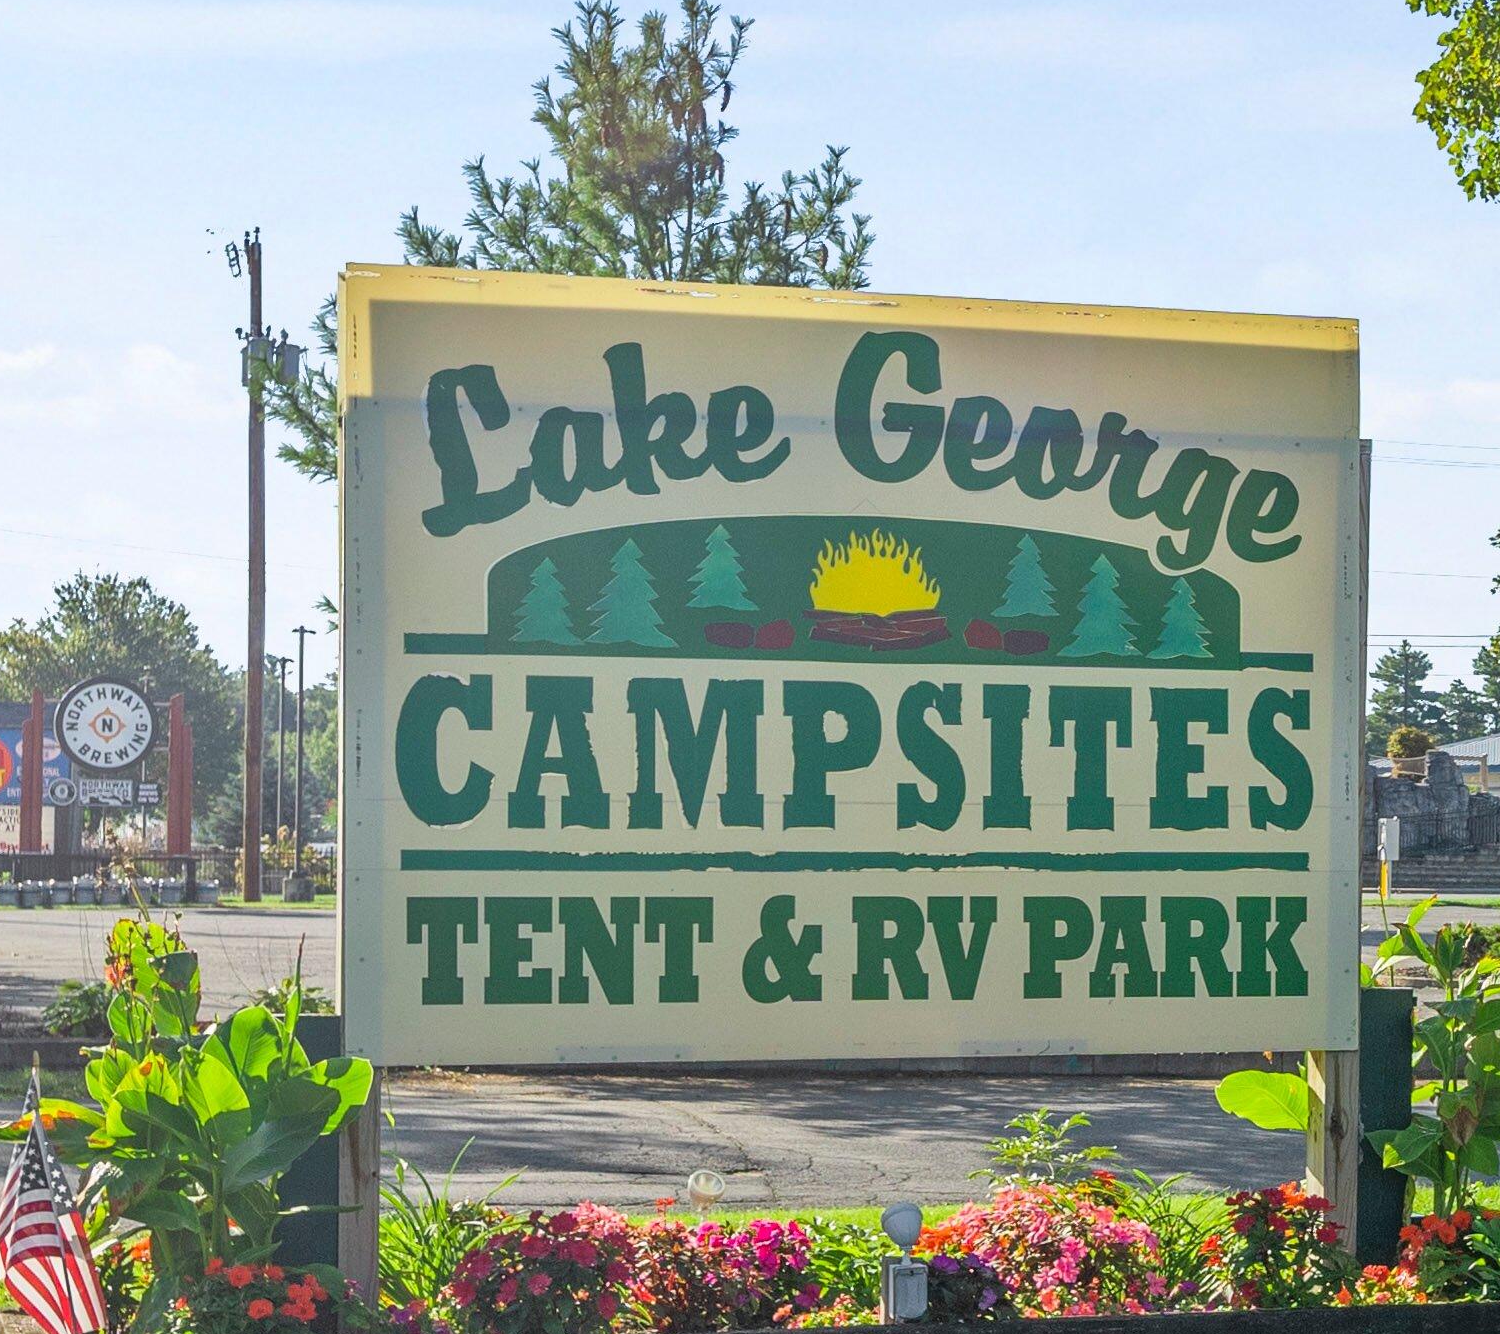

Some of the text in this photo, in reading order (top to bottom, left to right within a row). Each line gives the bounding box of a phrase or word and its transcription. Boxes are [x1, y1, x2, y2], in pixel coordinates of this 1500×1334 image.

[421, 330, 1303, 571] Lake George
[66, 687, 144, 731] NORTHWAY
[102, 718, 113, 732] N
[78, 723, 148, 764] BREWING
[394, 673, 1315, 831] CAMPSITES
[5, 824, 15, 832] AT
[405, 893, 1309, 1005] TENT & RV PARK
